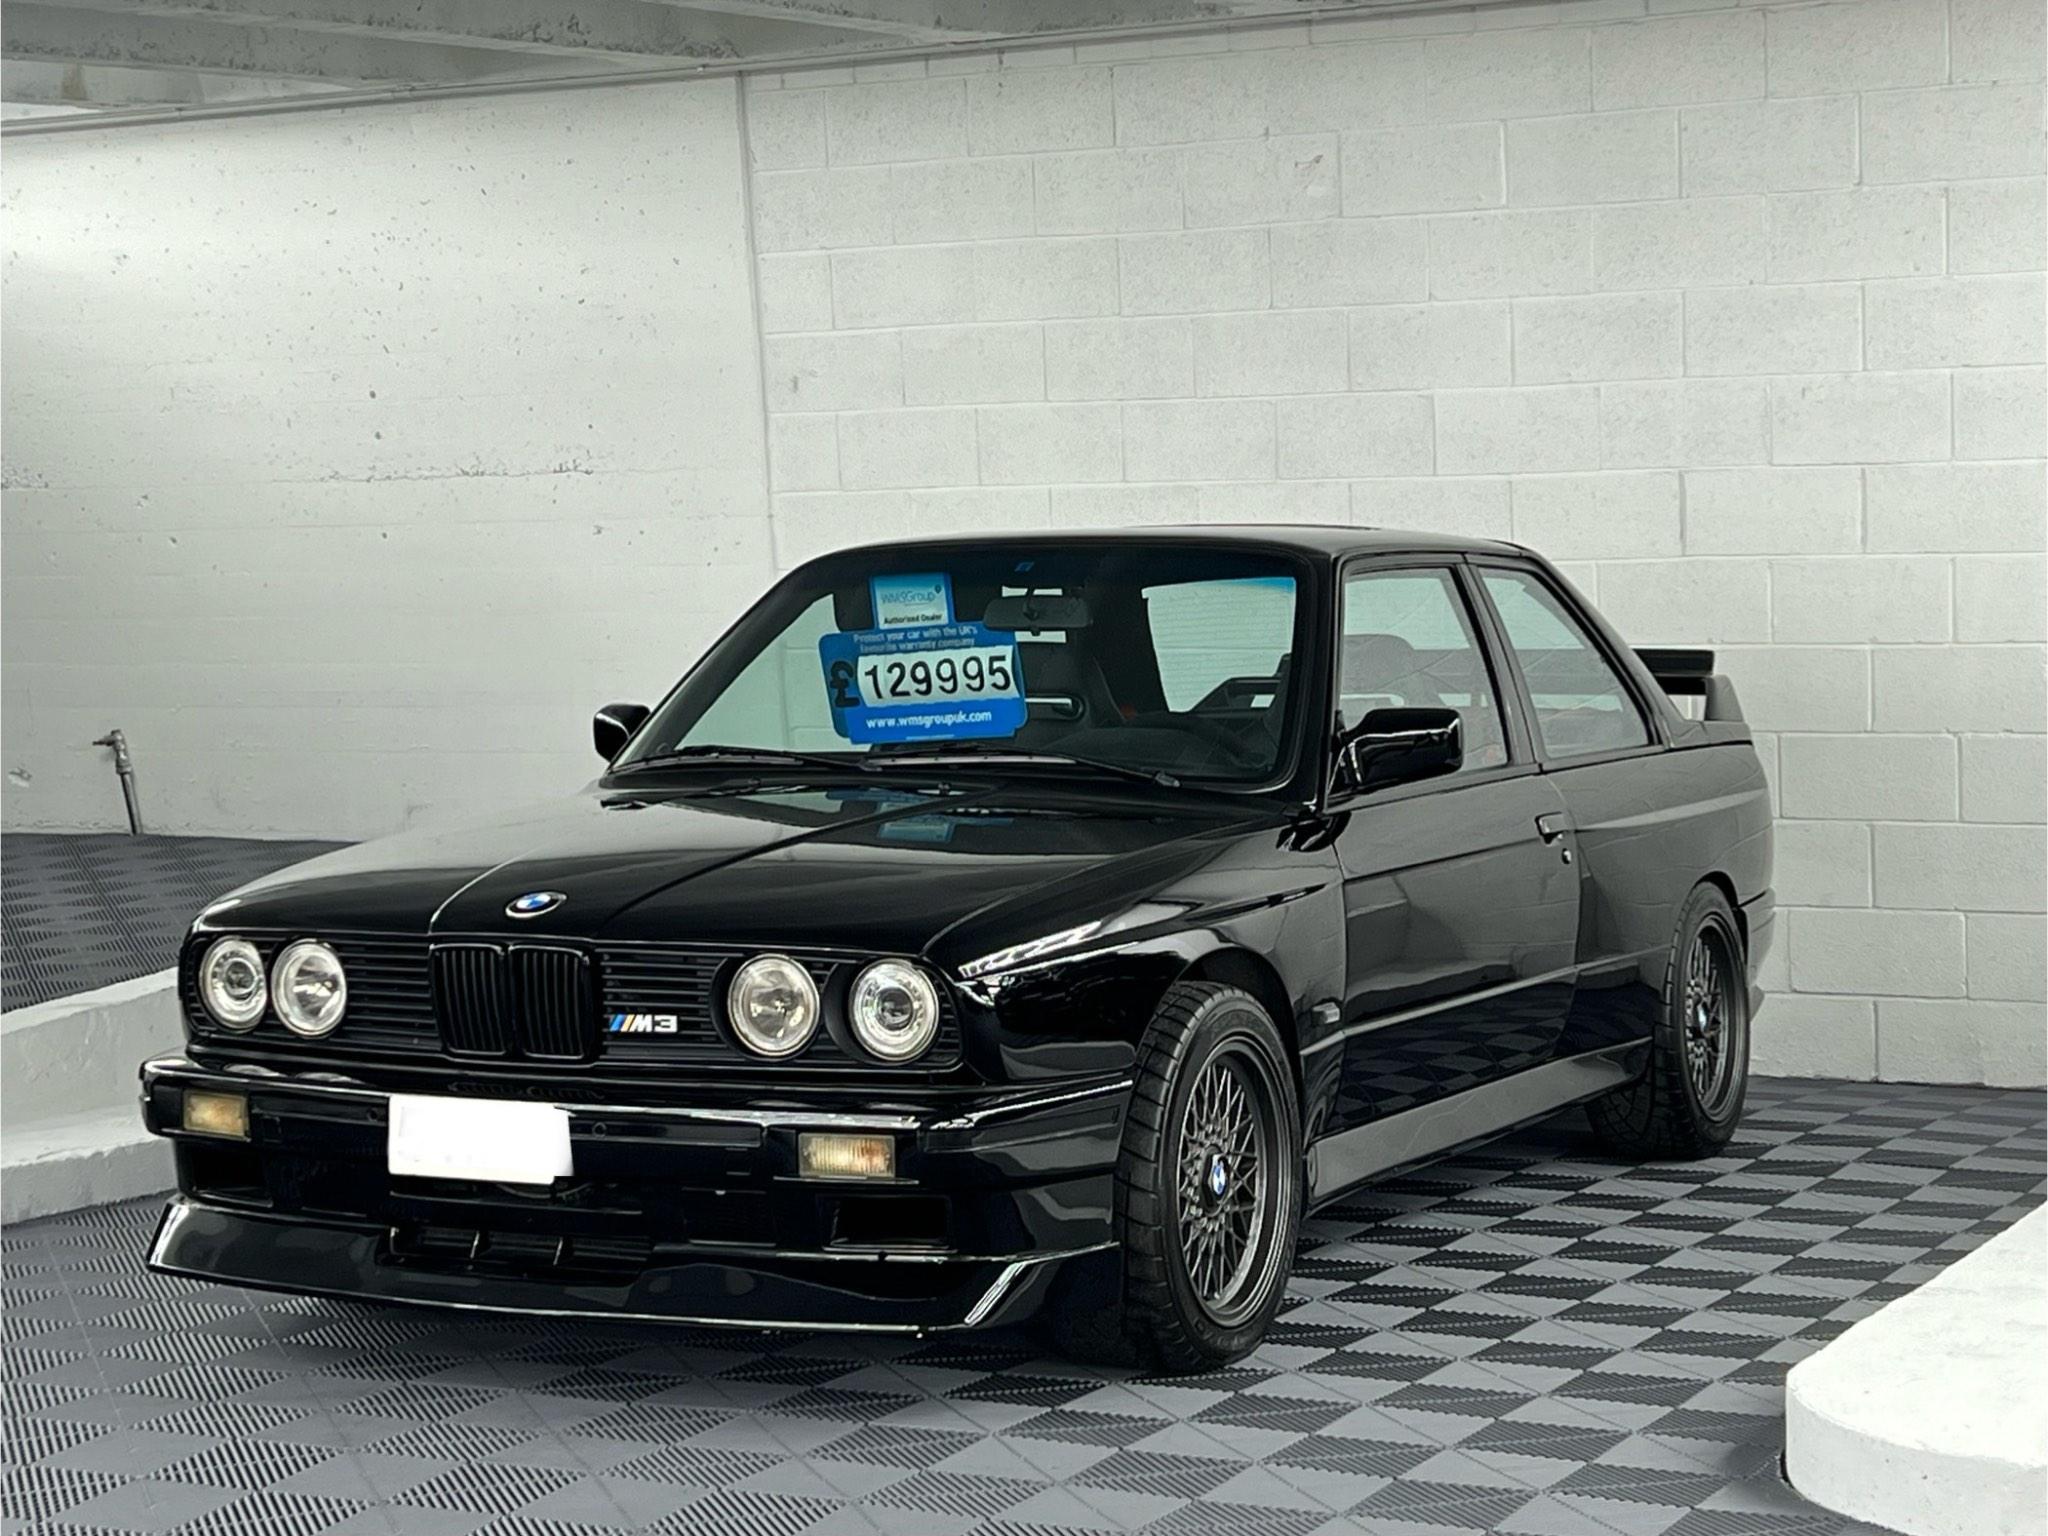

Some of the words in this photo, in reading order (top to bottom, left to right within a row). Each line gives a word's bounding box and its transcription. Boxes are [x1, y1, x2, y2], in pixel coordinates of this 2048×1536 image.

[921, 612, 943, 622] Dealer
[886, 631, 905, 643] your
[906, 630, 921, 640] car
[922, 628, 941, 639] with
[942, 626, 957, 637] the
[830, 660, 860, 707] £
[865, 655, 1011, 699] 129995
[866, 710, 992, 728] www.wmsgroupuk.com
